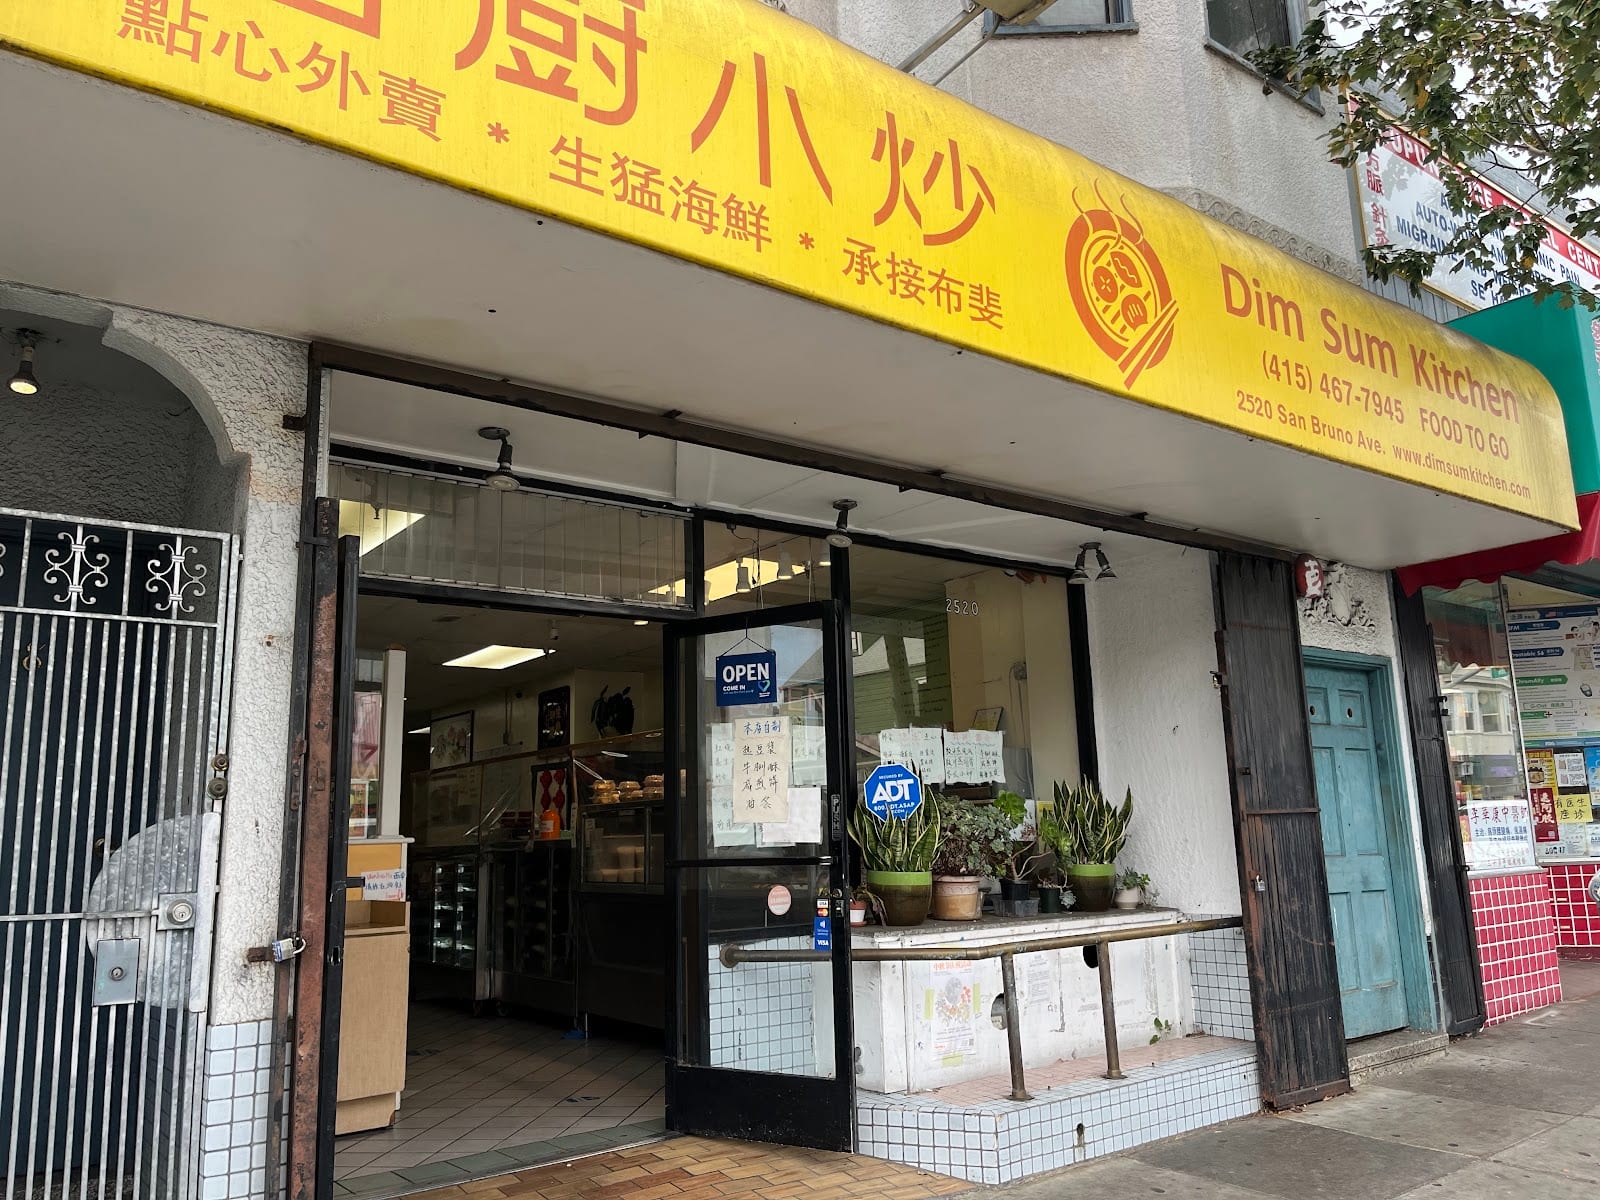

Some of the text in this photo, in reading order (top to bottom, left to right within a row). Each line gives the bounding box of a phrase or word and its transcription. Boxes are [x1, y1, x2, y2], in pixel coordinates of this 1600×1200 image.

[549, 135, 773, 254] 生猛海鮮
[841, 236, 1005, 331] 承接布斐
[1470, 279, 1486, 301] SE
[1221, 262, 1305, 342] Dim
[1319, 308, 1399, 378] Sum
[1409, 343, 1520, 424] Kitchen
[1262, 350, 1405, 425] (415) 467-7945
[1236, 390, 1532, 500] 2520 San Bruno Ave. www.dimsumkitchen.com
[1418, 407, 1510, 461] FOOD TO GO
[945, 598, 979, 616] 2520
[722, 662, 770, 683] OPEN
[871, 778, 915, 804] ADT
[873, 801, 916, 812] 800.DT.ASAP
